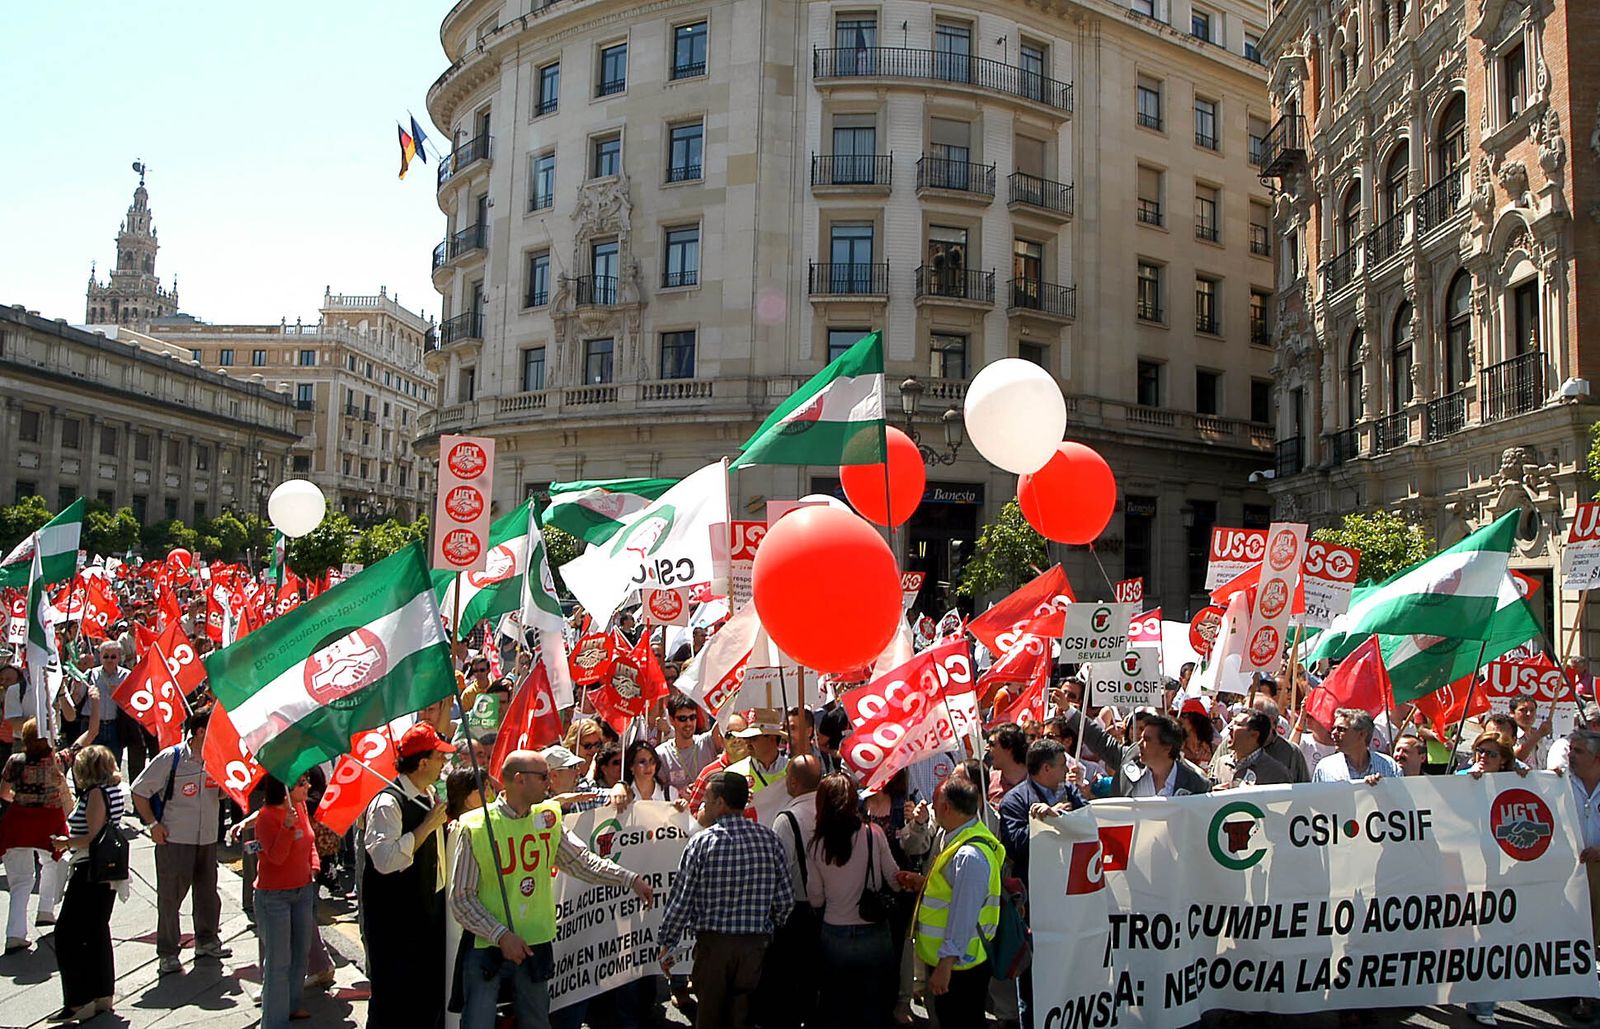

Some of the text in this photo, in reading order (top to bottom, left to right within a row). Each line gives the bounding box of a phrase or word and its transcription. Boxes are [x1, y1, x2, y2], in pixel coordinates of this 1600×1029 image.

[457, 446, 479, 457] UGT
[453, 489, 476, 500] UGT
[934, 488, 975, 501] Banesto
[450, 532, 473, 544] UGT
[1214, 530, 1265, 559] USO
[1117, 581, 1142, 602] USO
[581, 637, 606, 651] UGT
[1065, 636, 1125, 650] CSI CSIF
[1078, 652, 1111, 660] SEVILLA
[615, 662, 638, 680] UGT
[1493, 664, 1570, 699] USO
[1096, 681, 1158, 693] CSI CSIF
[1500, 803, 1540, 826] UGT
[620, 831, 644, 846] CSI
[1289, 809, 1432, 847] CSI CSIF
[495, 832, 551, 875] UGT
[555, 899, 574, 920] DEL
[576, 883, 631, 913] ACUERDO
[554, 907, 605, 943] RIBUTIVO
[609, 904, 617, 921] Y
[1106, 889, 1517, 951] TRO: CUMPLE LO ACORDADO
[576, 945, 594, 967] EN
[598, 927, 653, 960] MATERIA
[1164, 957, 1285, 1009] NEGOCIA
[1295, 956, 1353, 993] LAS
[1358, 939, 1591, 989] RETRIBUCIONES
